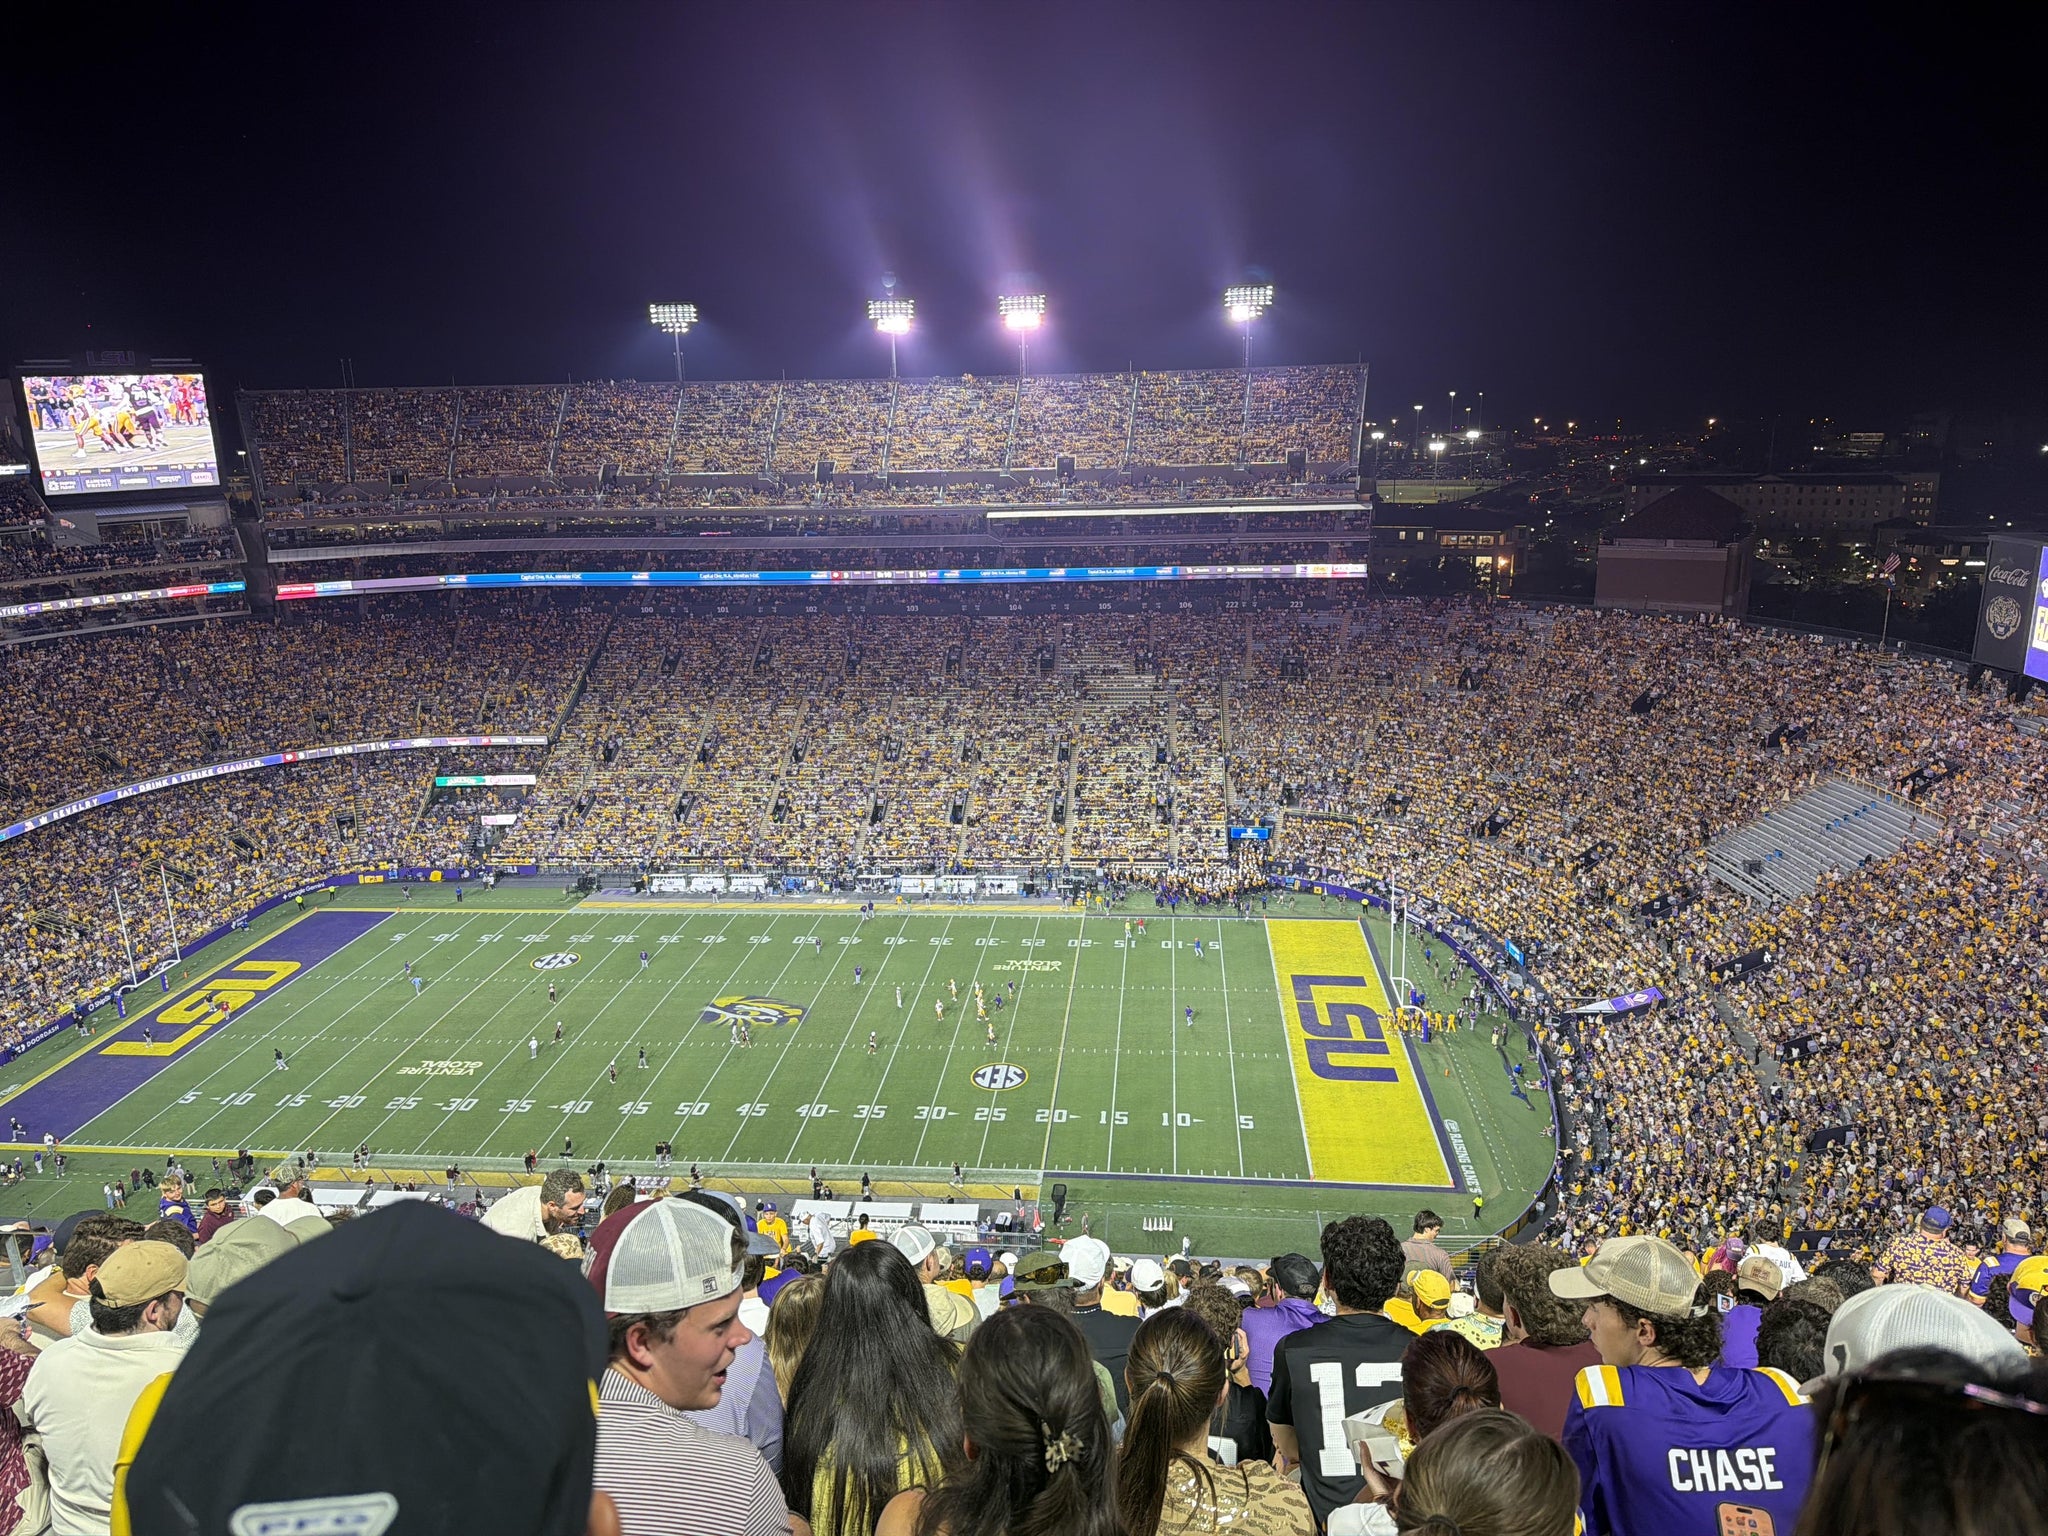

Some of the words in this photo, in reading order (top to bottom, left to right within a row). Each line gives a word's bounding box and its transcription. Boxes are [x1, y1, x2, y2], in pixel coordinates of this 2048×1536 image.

[86, 350, 135, 367] LSU
[906, 604, 919, 612] 103
[1009, 603, 1022, 611] 104
[1098, 602, 1112, 610] 105
[1179, 601, 1192, 609] 106
[1225, 601, 1239, 609] 222
[1290, 600, 1303, 608] 223
[138, 778, 169, 793] DRINK
[181, 768, 214, 783] STRIKE
[52, 798, 98, 820] REVELRY
[287, 888, 305, 900] Google
[305, 881, 325, 893] Gemini
[389, 933, 408, 942] 5
[432, 933, 461, 942] 10
[476, 934, 504, 943] 15
[520, 934, 550, 943] 20
[565, 934, 595, 943] 25
[611, 935, 640, 943] 30
[656, 935, 684, 944] 35
[701, 935, 728, 944] 40
[747, 935, 772, 944] 45
[791, 936, 817, 944] 50
[837, 936, 862, 945] 45
[883, 936, 908, 945] 40
[928, 937, 954, 946] 35
[975, 937, 1000, 947] 30
[1020, 938, 1046, 947] 25
[1067, 939, 1092, 948] 20
[1114, 940, 1136, 949] 15
[1160, 940, 1183, 949] 10
[1208, 941, 1220, 950] 5
[533, 953, 580, 970] SEC
[992, 964, 1061, 972] VENTURE
[98, 960, 302, 1057] LSU
[1290, 974, 1400, 1083] LSU
[26, 1024, 60, 1047] DOORDASH
[421, 1060, 484, 1068] GLOBAL
[396, 1066, 475, 1076] VENTURE
[973, 1064, 1026, 1089] SEC
[177, 1091, 203, 1104] 5
[219, 1092, 257, 1105] 10
[275, 1094, 312, 1107] 15
[328, 1095, 367, 1109] 20
[384, 1096, 423, 1110] 25
[441, 1098, 479, 1111] 30
[499, 1099, 536, 1112] 35
[559, 1100, 594, 1114] 40
[618, 1101, 652, 1115] 45
[674, 1102, 711, 1116] 50
[735, 1103, 769, 1117] 45
[795, 1104, 829, 1117] 40
[853, 1105, 888, 1119] 35
[913, 1106, 947, 1120] 30
[973, 1107, 1007, 1121] 25
[1035, 1109, 1068, 1123] 20
[1099, 1110, 1129, 1125] 15
[1161, 1112, 1191, 1127] 10
[1239, 1115, 1254, 1129] 5
[1448, 1131, 1471, 1163] RAISING
[1461, 1164, 1482, 1194] CANE'S
[1668, 1447, 1784, 1492] CHASE
